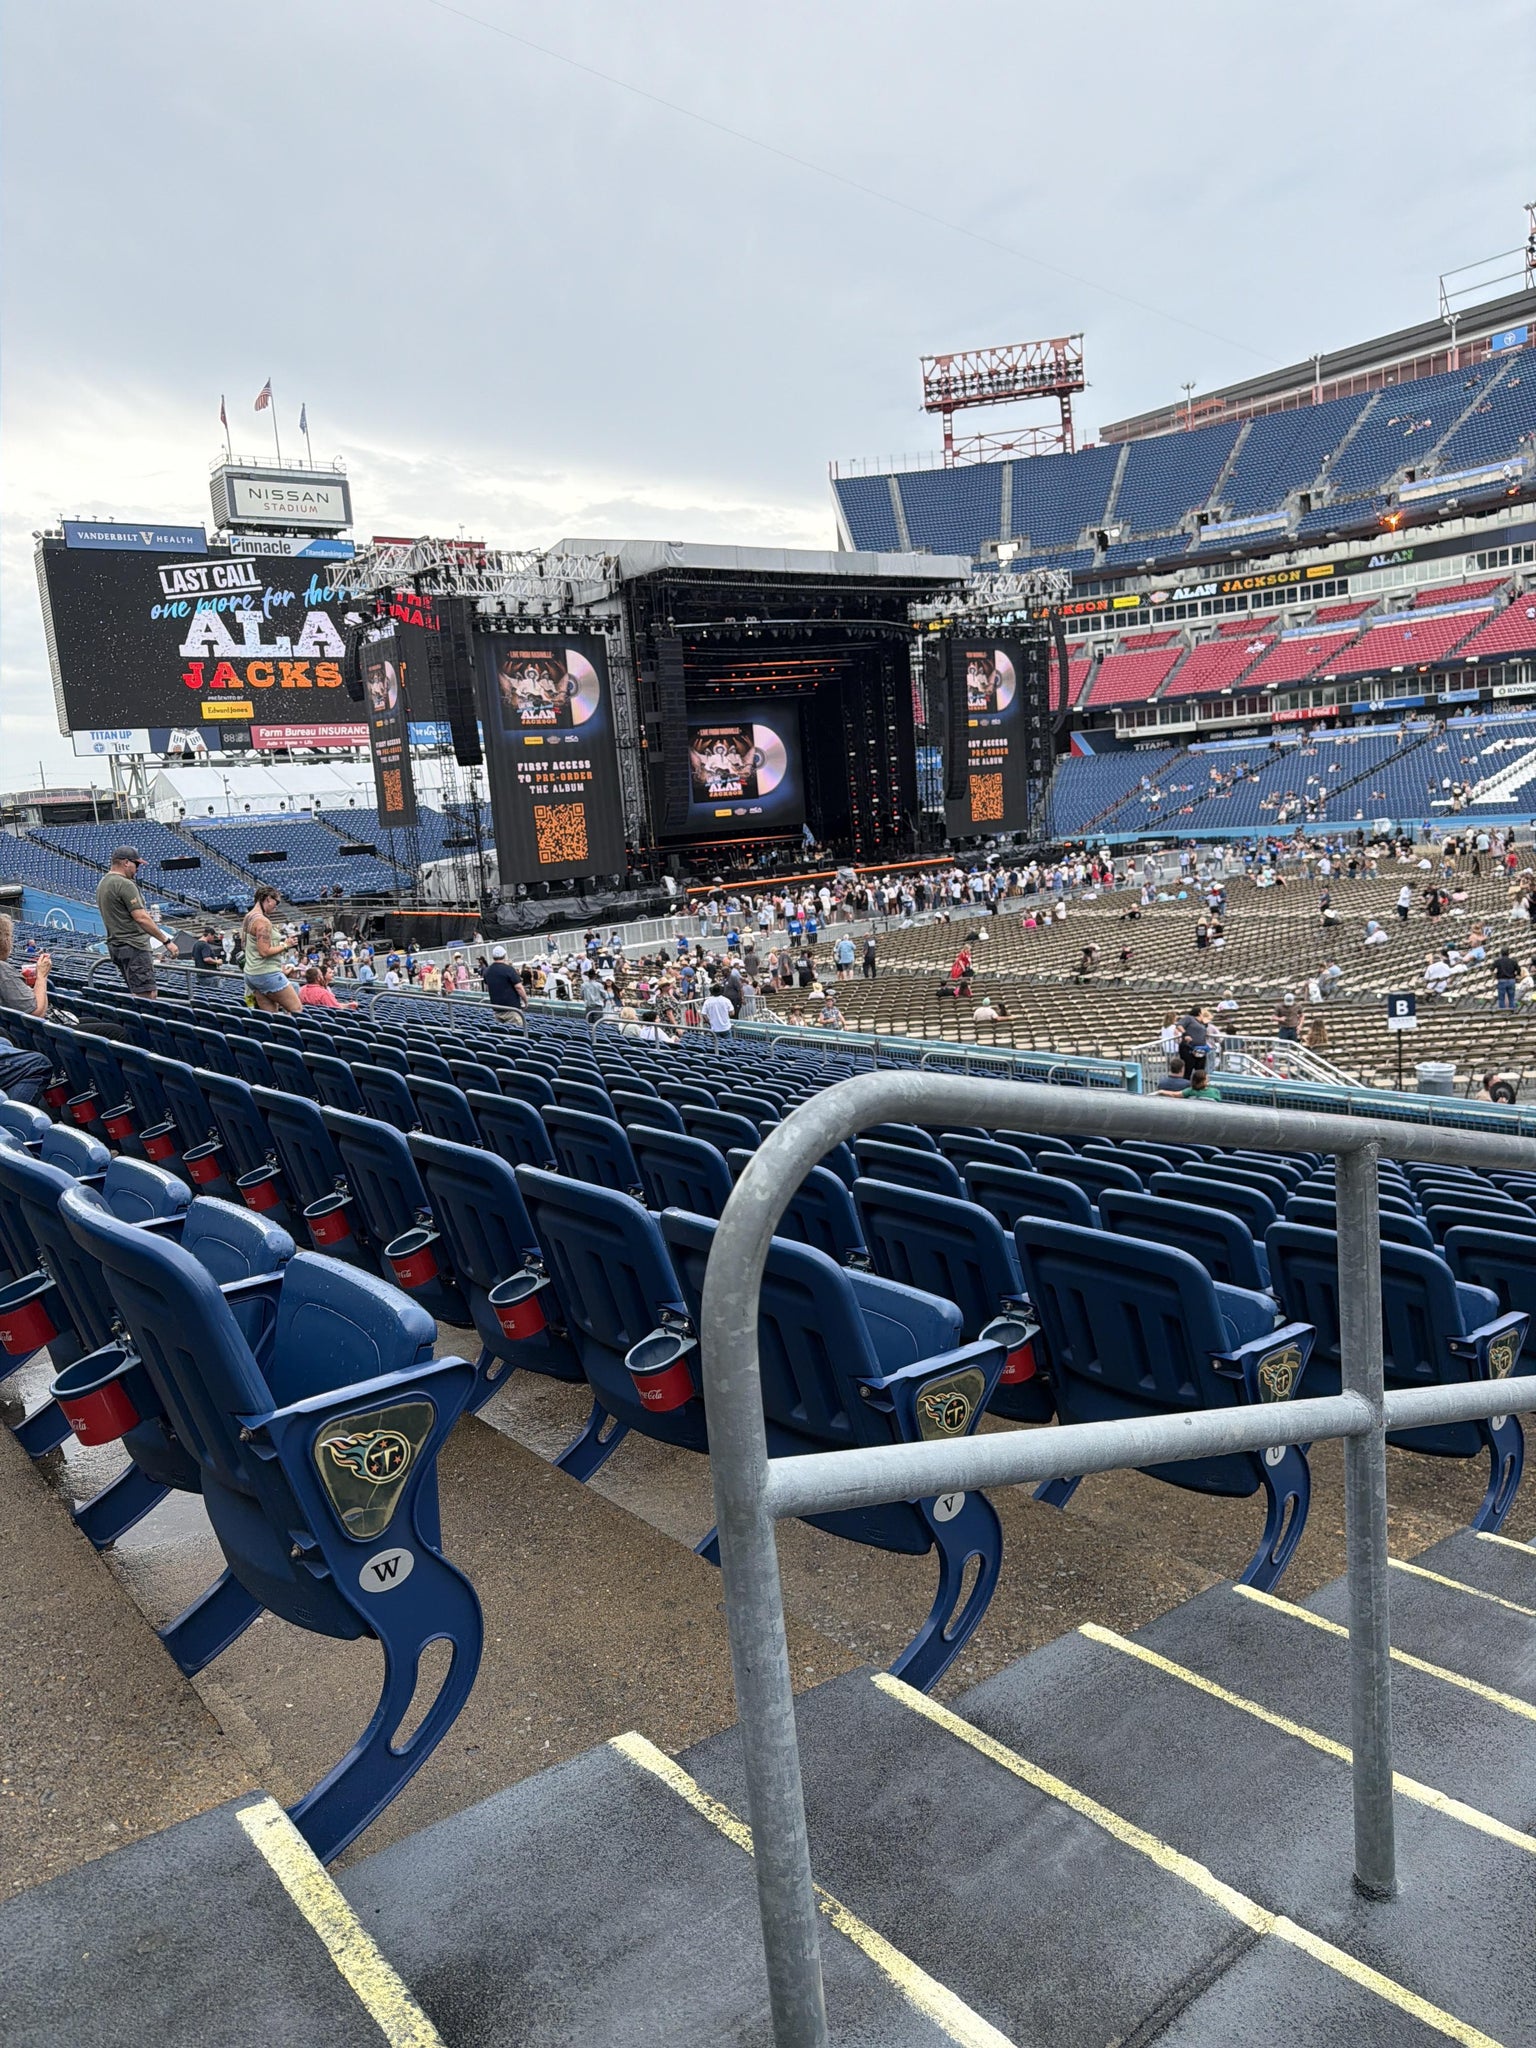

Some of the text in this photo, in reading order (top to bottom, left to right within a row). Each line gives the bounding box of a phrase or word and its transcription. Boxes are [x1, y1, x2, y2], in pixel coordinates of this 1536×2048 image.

[249, 488, 329, 504] NISSAN
[264, 502, 318, 513] STADIUM
[77, 531, 138, 542] VANDERBILT
[157, 535, 194, 544] HEALTH
[231, 537, 292, 555] Pinnacle
[1368, 549, 1415, 567] ALAN
[159, 563, 262, 594] LAST CALL
[1172, 583, 1218, 600] ALAN
[1222, 570, 1301, 593] JACKSON
[150, 600, 191, 620] one
[196, 594, 255, 614] more
[261, 586, 296, 620] for
[179, 609, 346, 658] ALA
[182, 660, 343, 689] JACKS
[521, 710, 556, 719] ALAN
[90, 731, 132, 741] TITAN UP
[259, 729, 283, 738] Farm
[285, 728, 317, 737] Bureau
[517, 760, 591, 772] FIRST ACCESS
[518, 771, 593, 783] TO PRE-ORDER
[529, 783, 584, 794] THE ALBUM
[709, 781, 742, 793] ALAN
[233, 815, 259, 823] TITANS
[602, 959, 610, 969] A
[1395, 999, 1409, 1015] B
[942, 1494, 956, 1513] V
[371, 1556, 402, 1582] W
